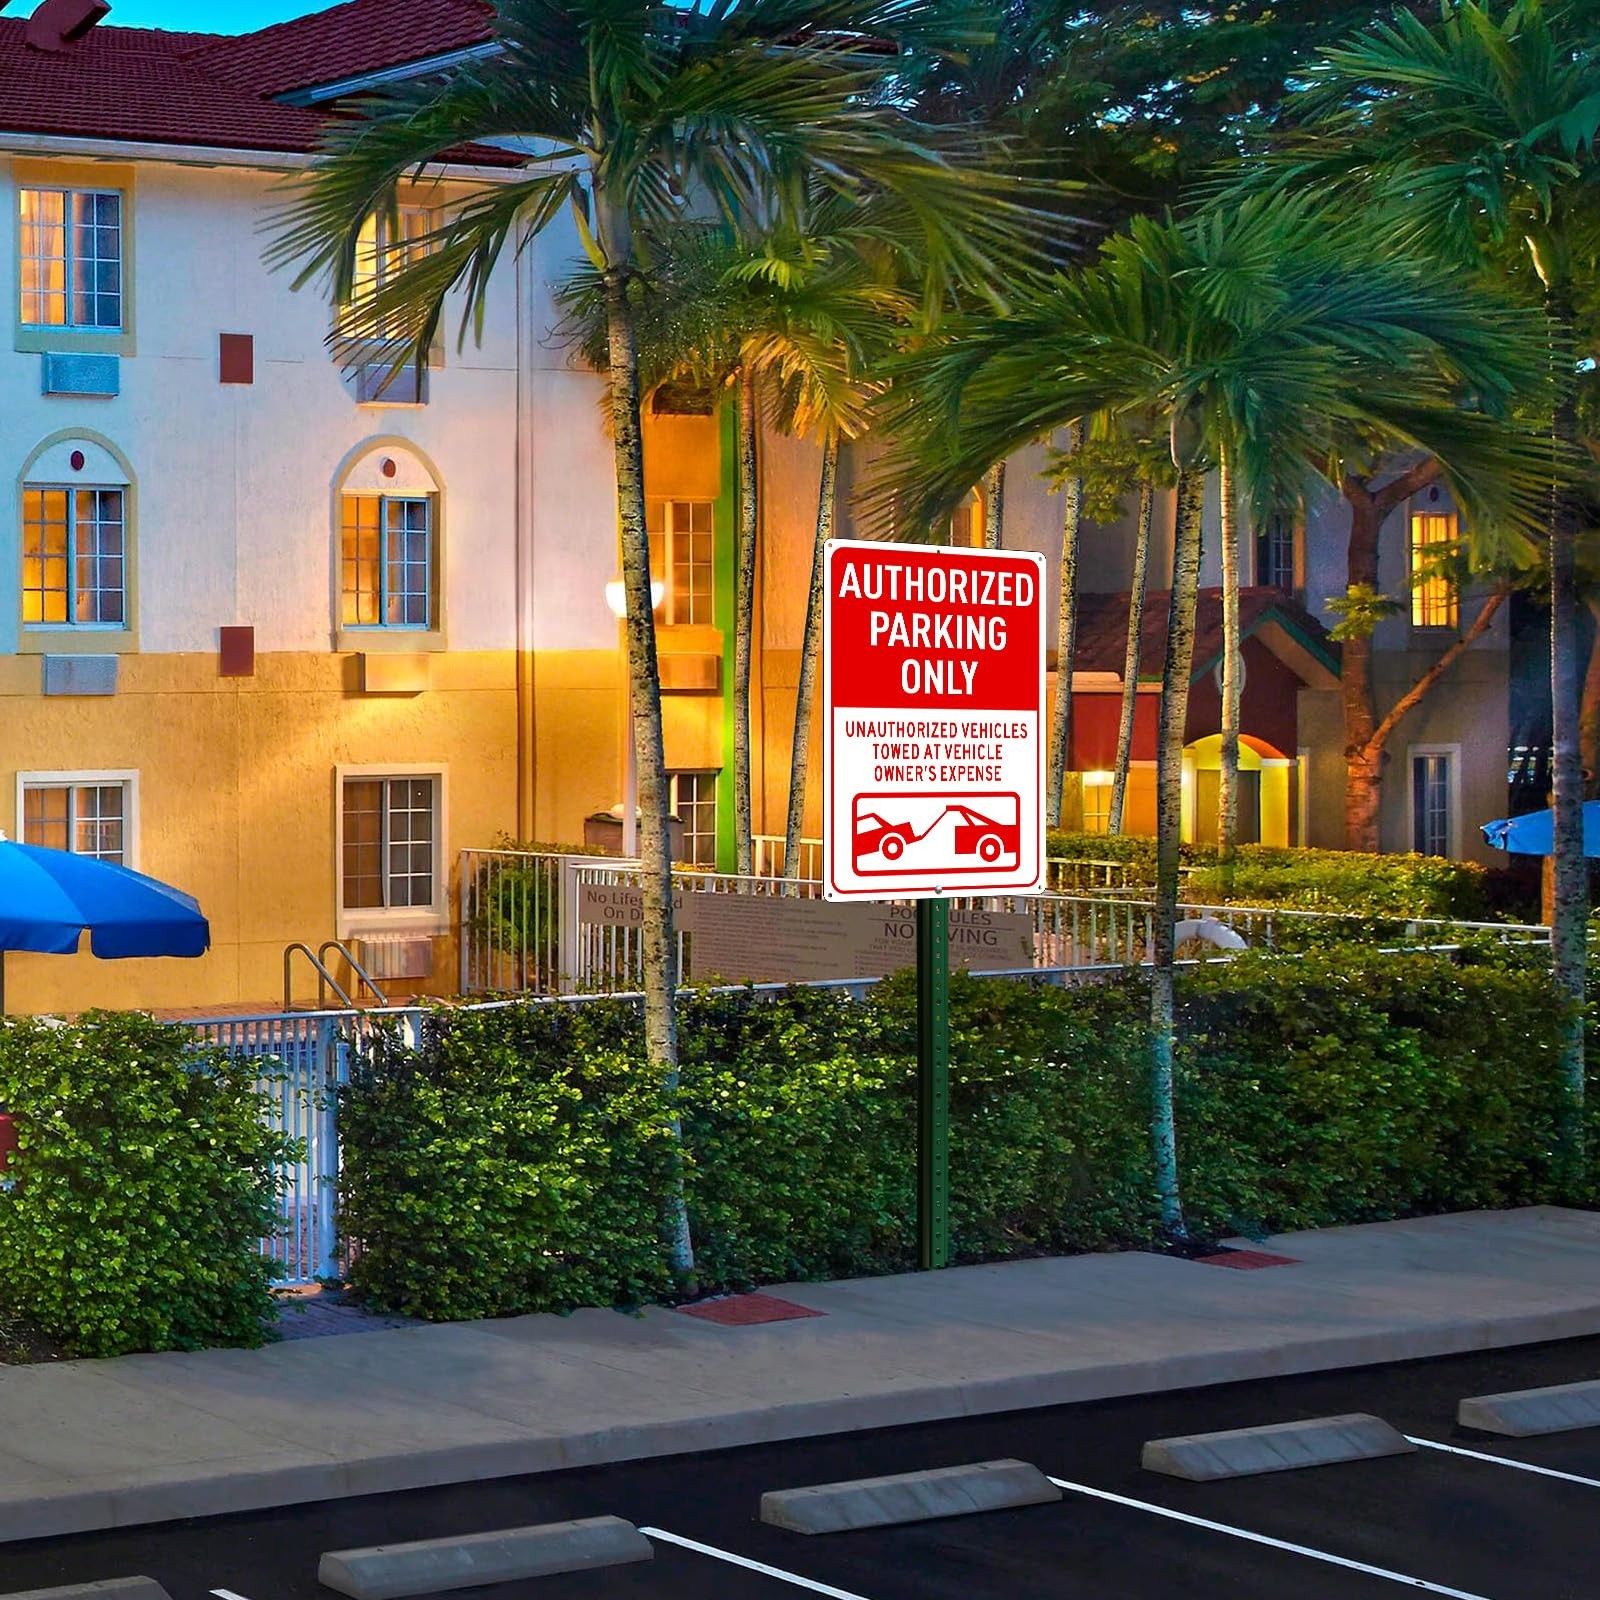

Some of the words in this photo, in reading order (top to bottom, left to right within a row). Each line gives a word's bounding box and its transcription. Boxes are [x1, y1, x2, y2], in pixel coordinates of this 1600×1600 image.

[839, 562, 1035, 607] AUTHORIZED
[870, 611, 1007, 651] PARKING
[901, 659, 979, 695] ONLY
[845, 721, 957, 739] UNAUTHORIZED
[961, 722, 1028, 739] VEHICLES
[872, 744, 920, 760] TOWED
[924, 744, 942, 760] AT
[945, 744, 1003, 760] VEHICLE
[874, 765, 937, 782] OWNER'S
[940, 766, 1002, 782] EXPENSE
[587, 891, 607, 904] No
[612, 892, 683, 909] Lifed
[603, 906, 624, 919] On
[949, 911, 992, 925] ULES
[884, 922, 915, 939] NO
[947, 928, 997, 946] VING
